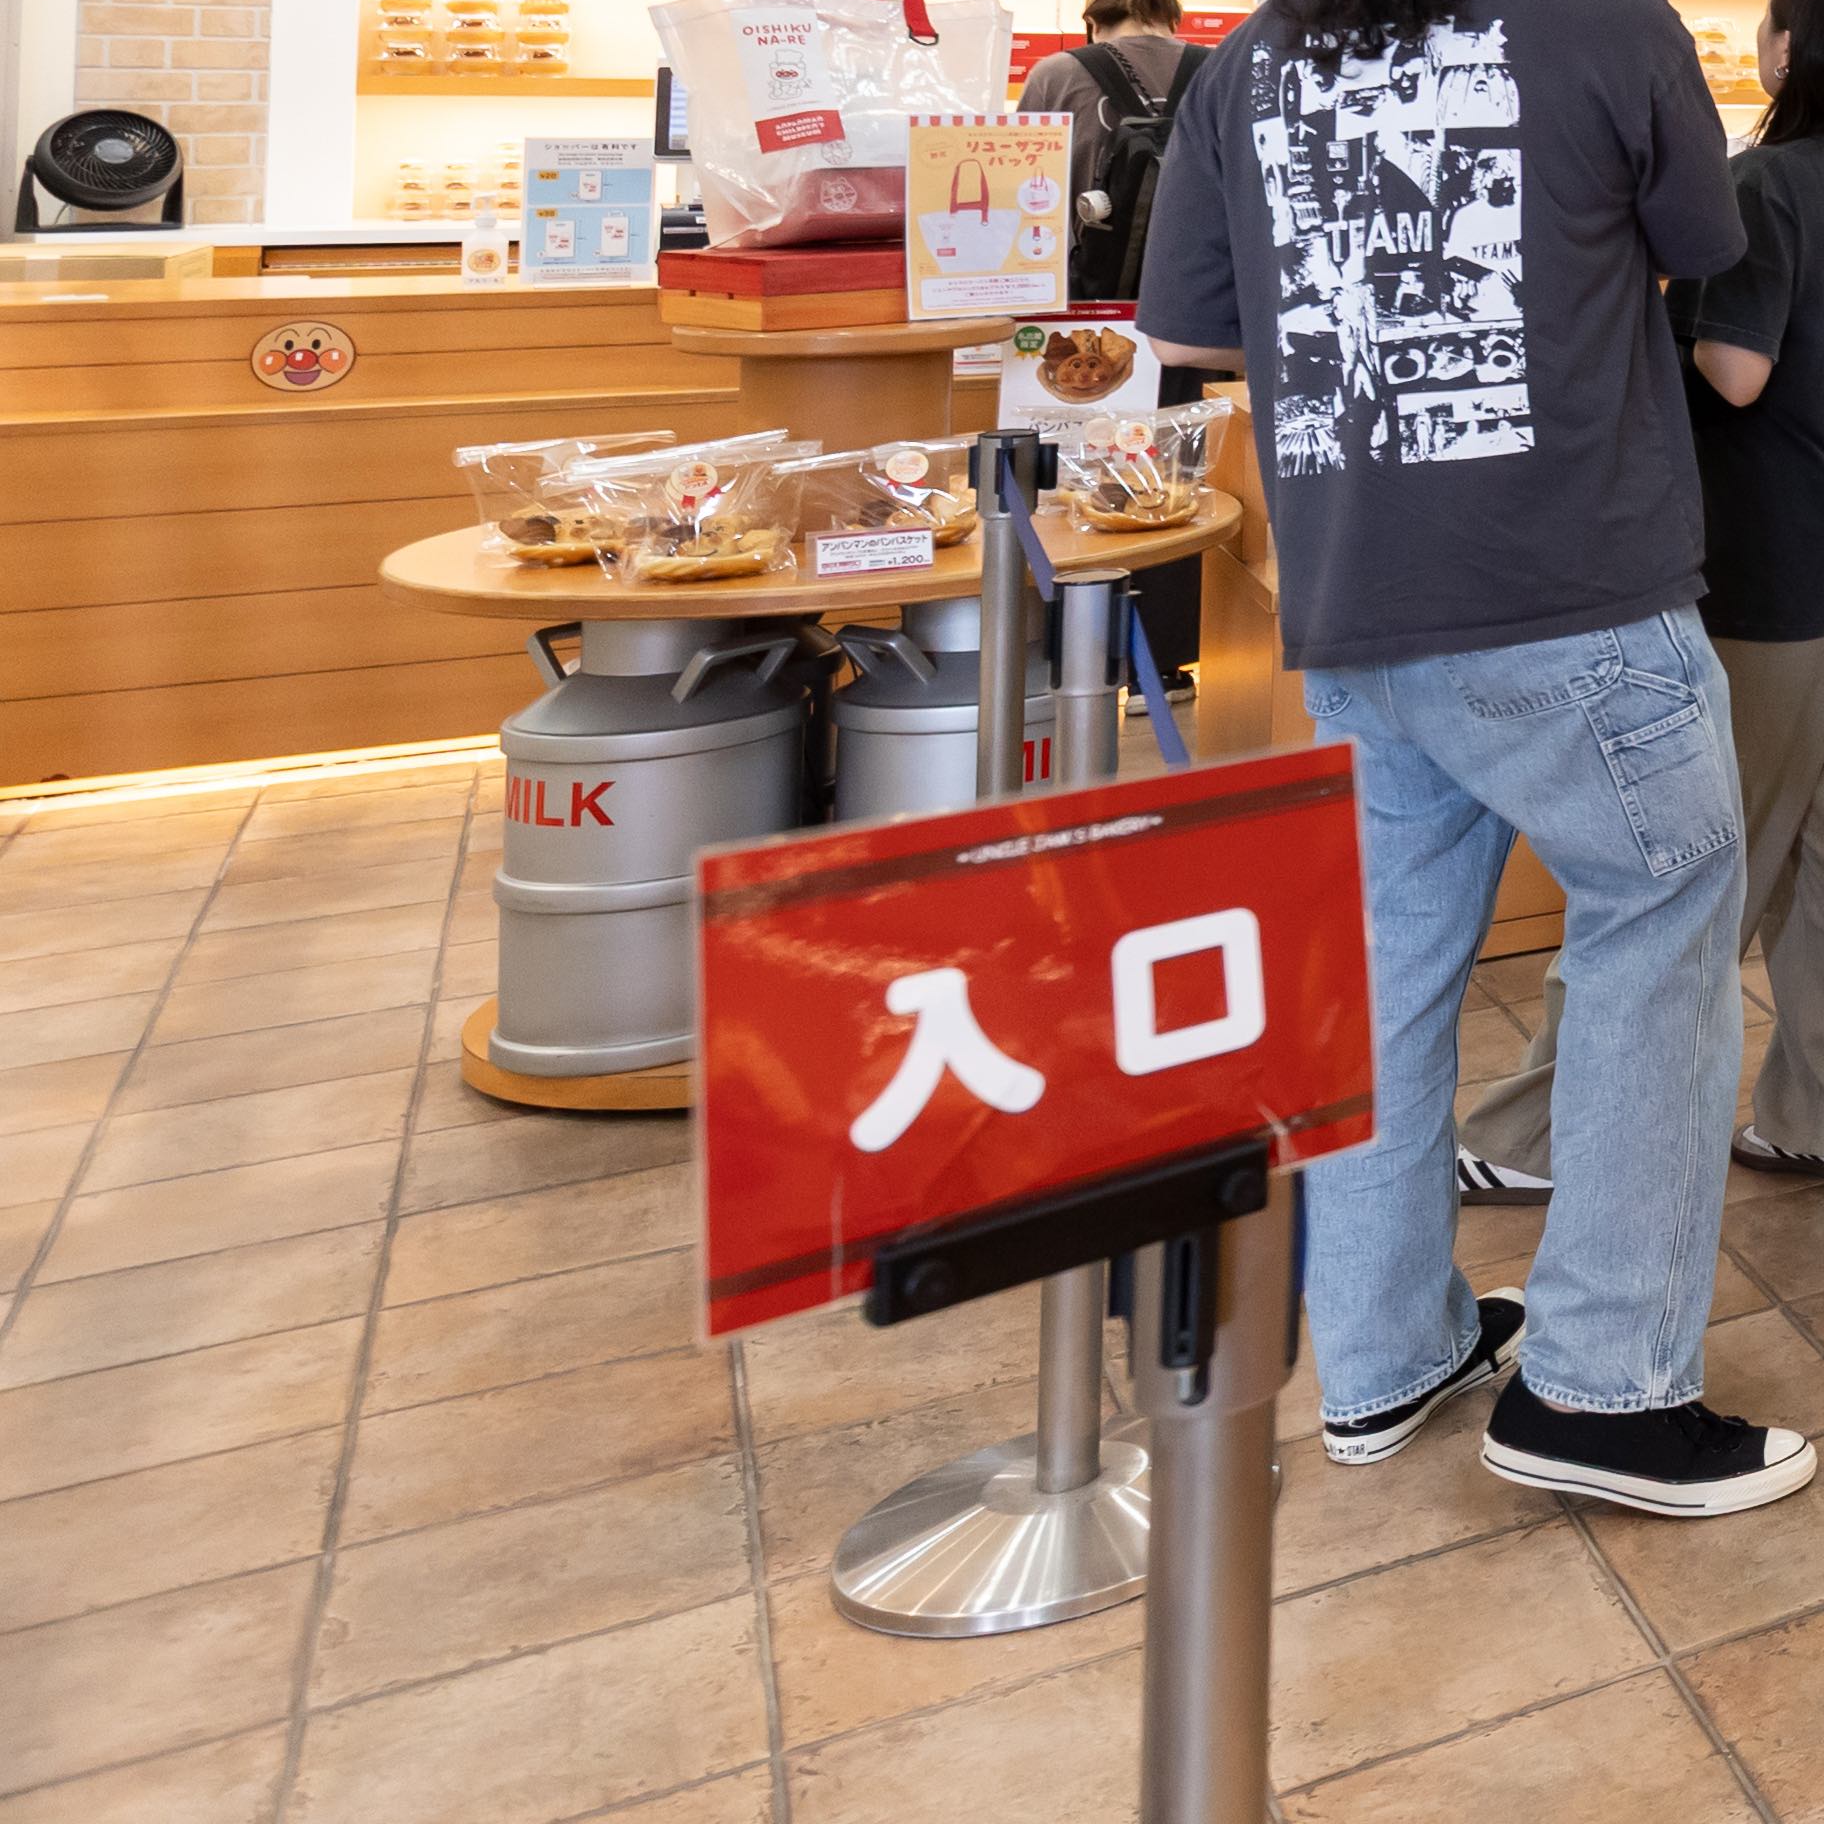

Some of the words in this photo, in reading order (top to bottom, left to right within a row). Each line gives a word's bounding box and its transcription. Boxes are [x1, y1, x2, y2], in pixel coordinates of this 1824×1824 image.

[742, 23, 812, 36] OISHIKU
[757, 35, 806, 46] NA-RE
[1324, 210, 1433, 262] TEAM
[822, 535, 928, 552] アンパンマンのパンバスケット
[505, 776, 616, 827] MILK
[849, 907, 1266, 1153] 入口
